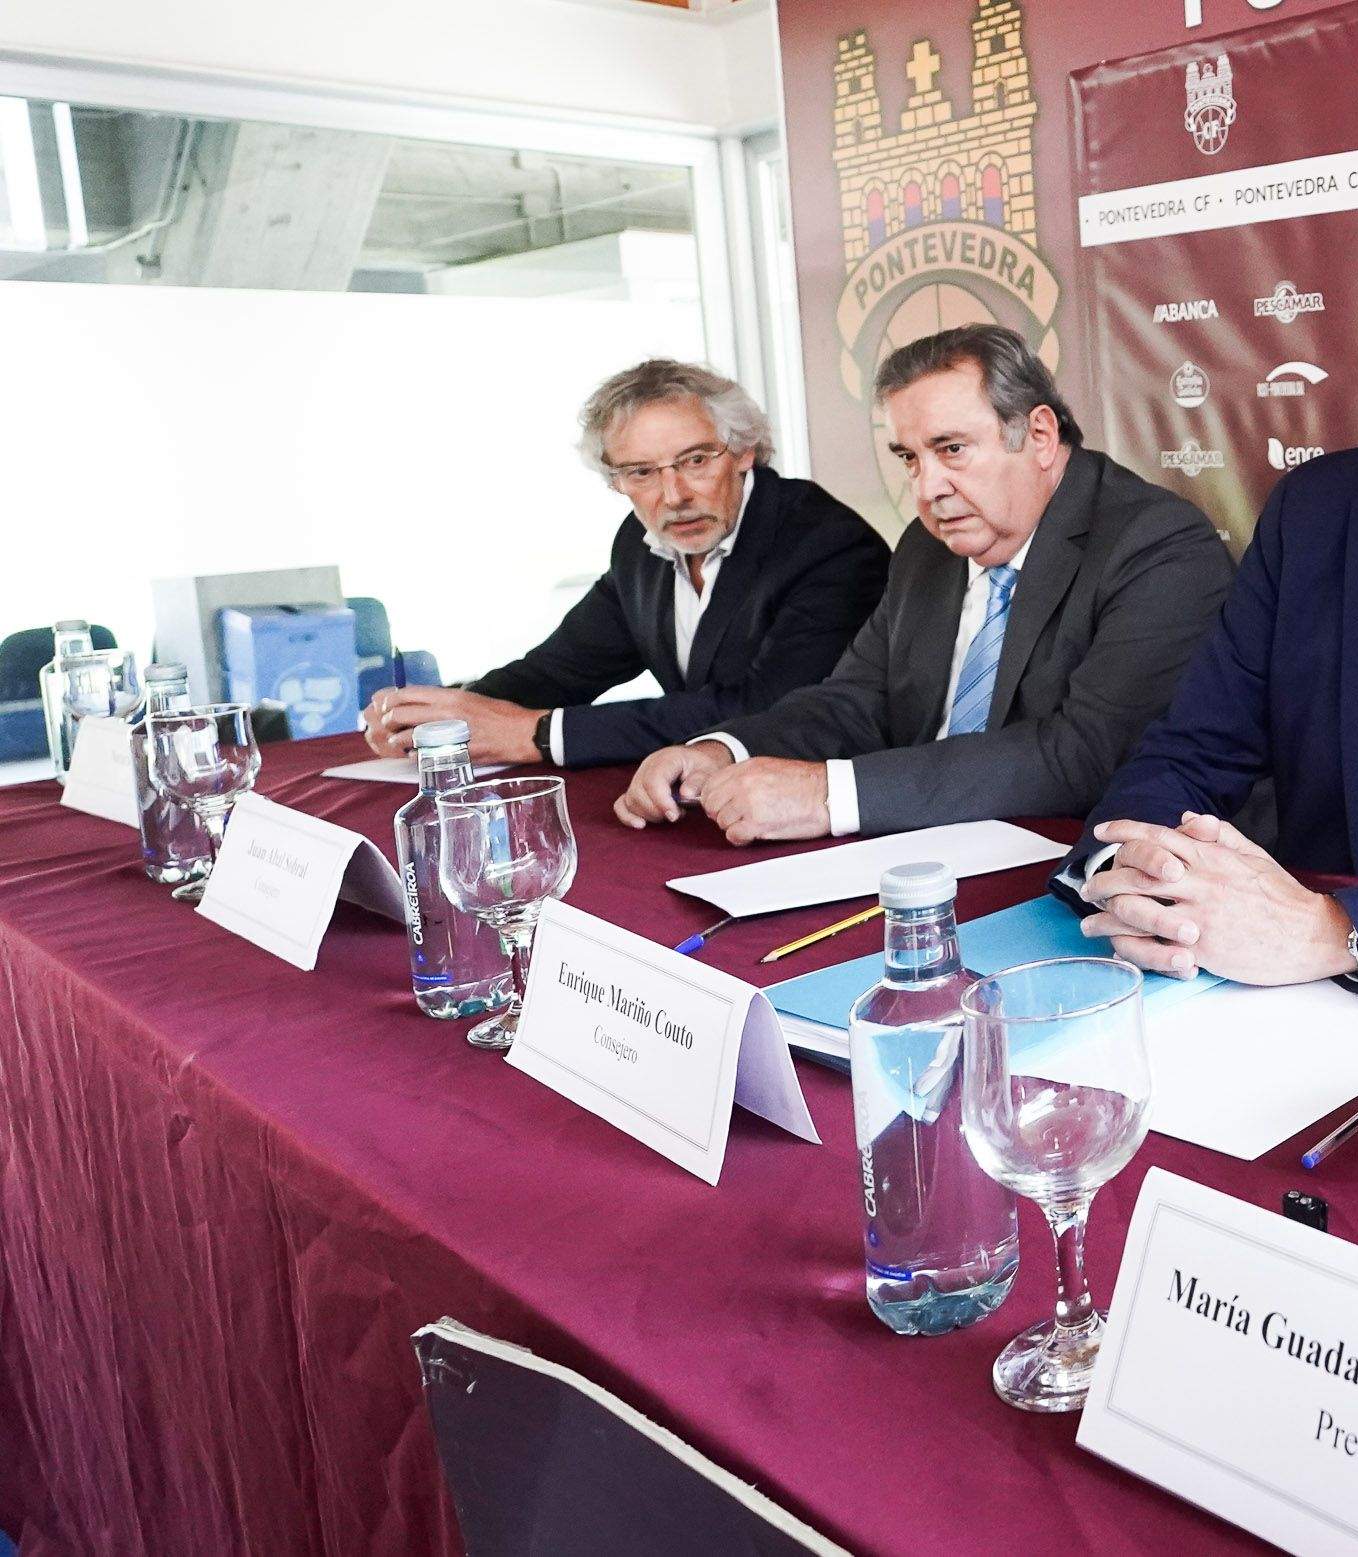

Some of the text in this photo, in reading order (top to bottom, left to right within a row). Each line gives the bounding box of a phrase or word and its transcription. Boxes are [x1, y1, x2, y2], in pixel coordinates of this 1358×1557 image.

[1098, 200, 1186, 226] PONTEVEDRA
[1194, 194, 1211, 212] CF
[1235, 174, 1339, 205] PONTEVEDRA
[853, 230, 1036, 311] PONTEVEDRA
[1254, 293, 1326, 317] PESCAMAR
[405, 862, 424, 945] CABREIROA
[557, 960, 694, 1052] Enrique Mariño Couto
[592, 1023, 639, 1066] Consejero
[1166, 1267, 1251, 1338] María
